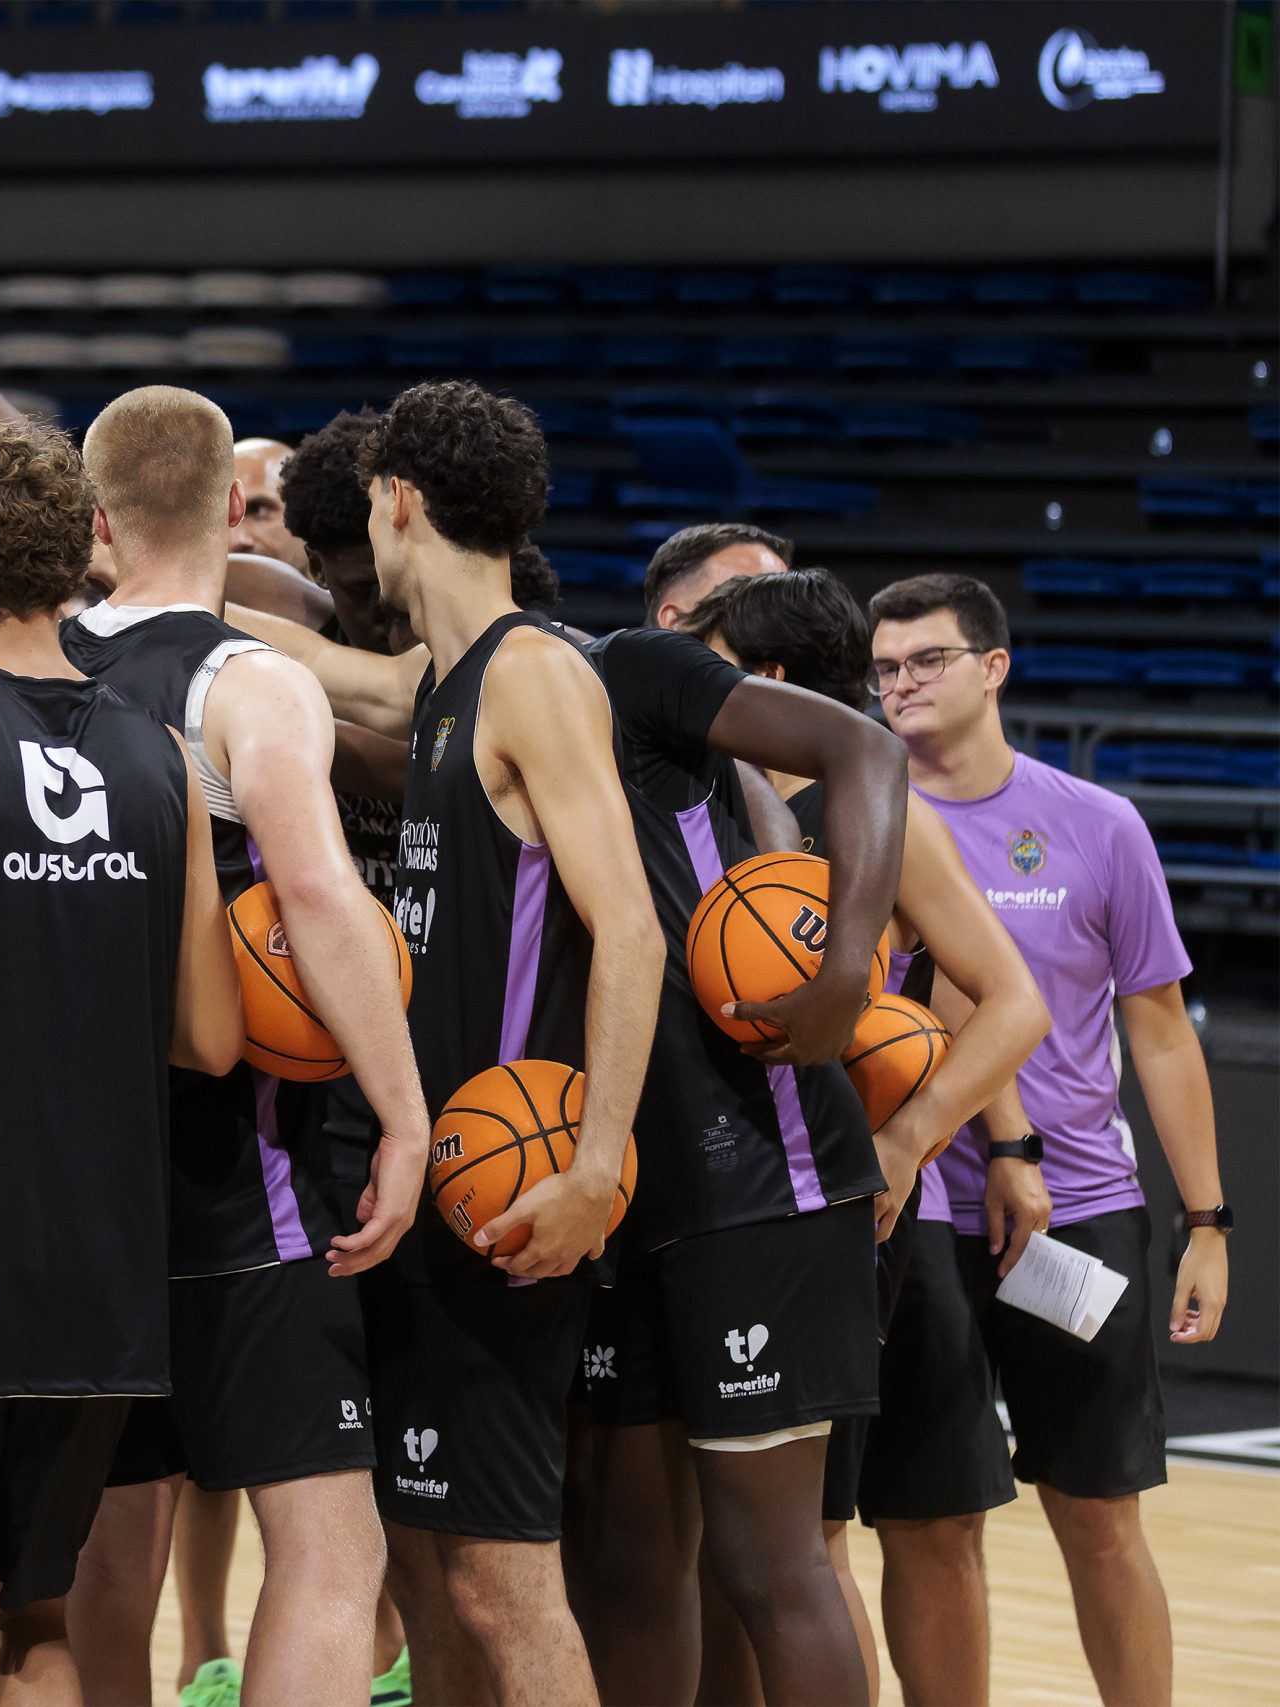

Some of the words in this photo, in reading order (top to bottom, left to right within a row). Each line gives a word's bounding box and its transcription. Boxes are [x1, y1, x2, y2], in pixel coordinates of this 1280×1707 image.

[3, 851, 148, 882] austral
[986, 887, 1067, 911] tenerife!
[718, 1371, 781, 1394] tenerife!
[396, 1475, 449, 1499] tenerife!
